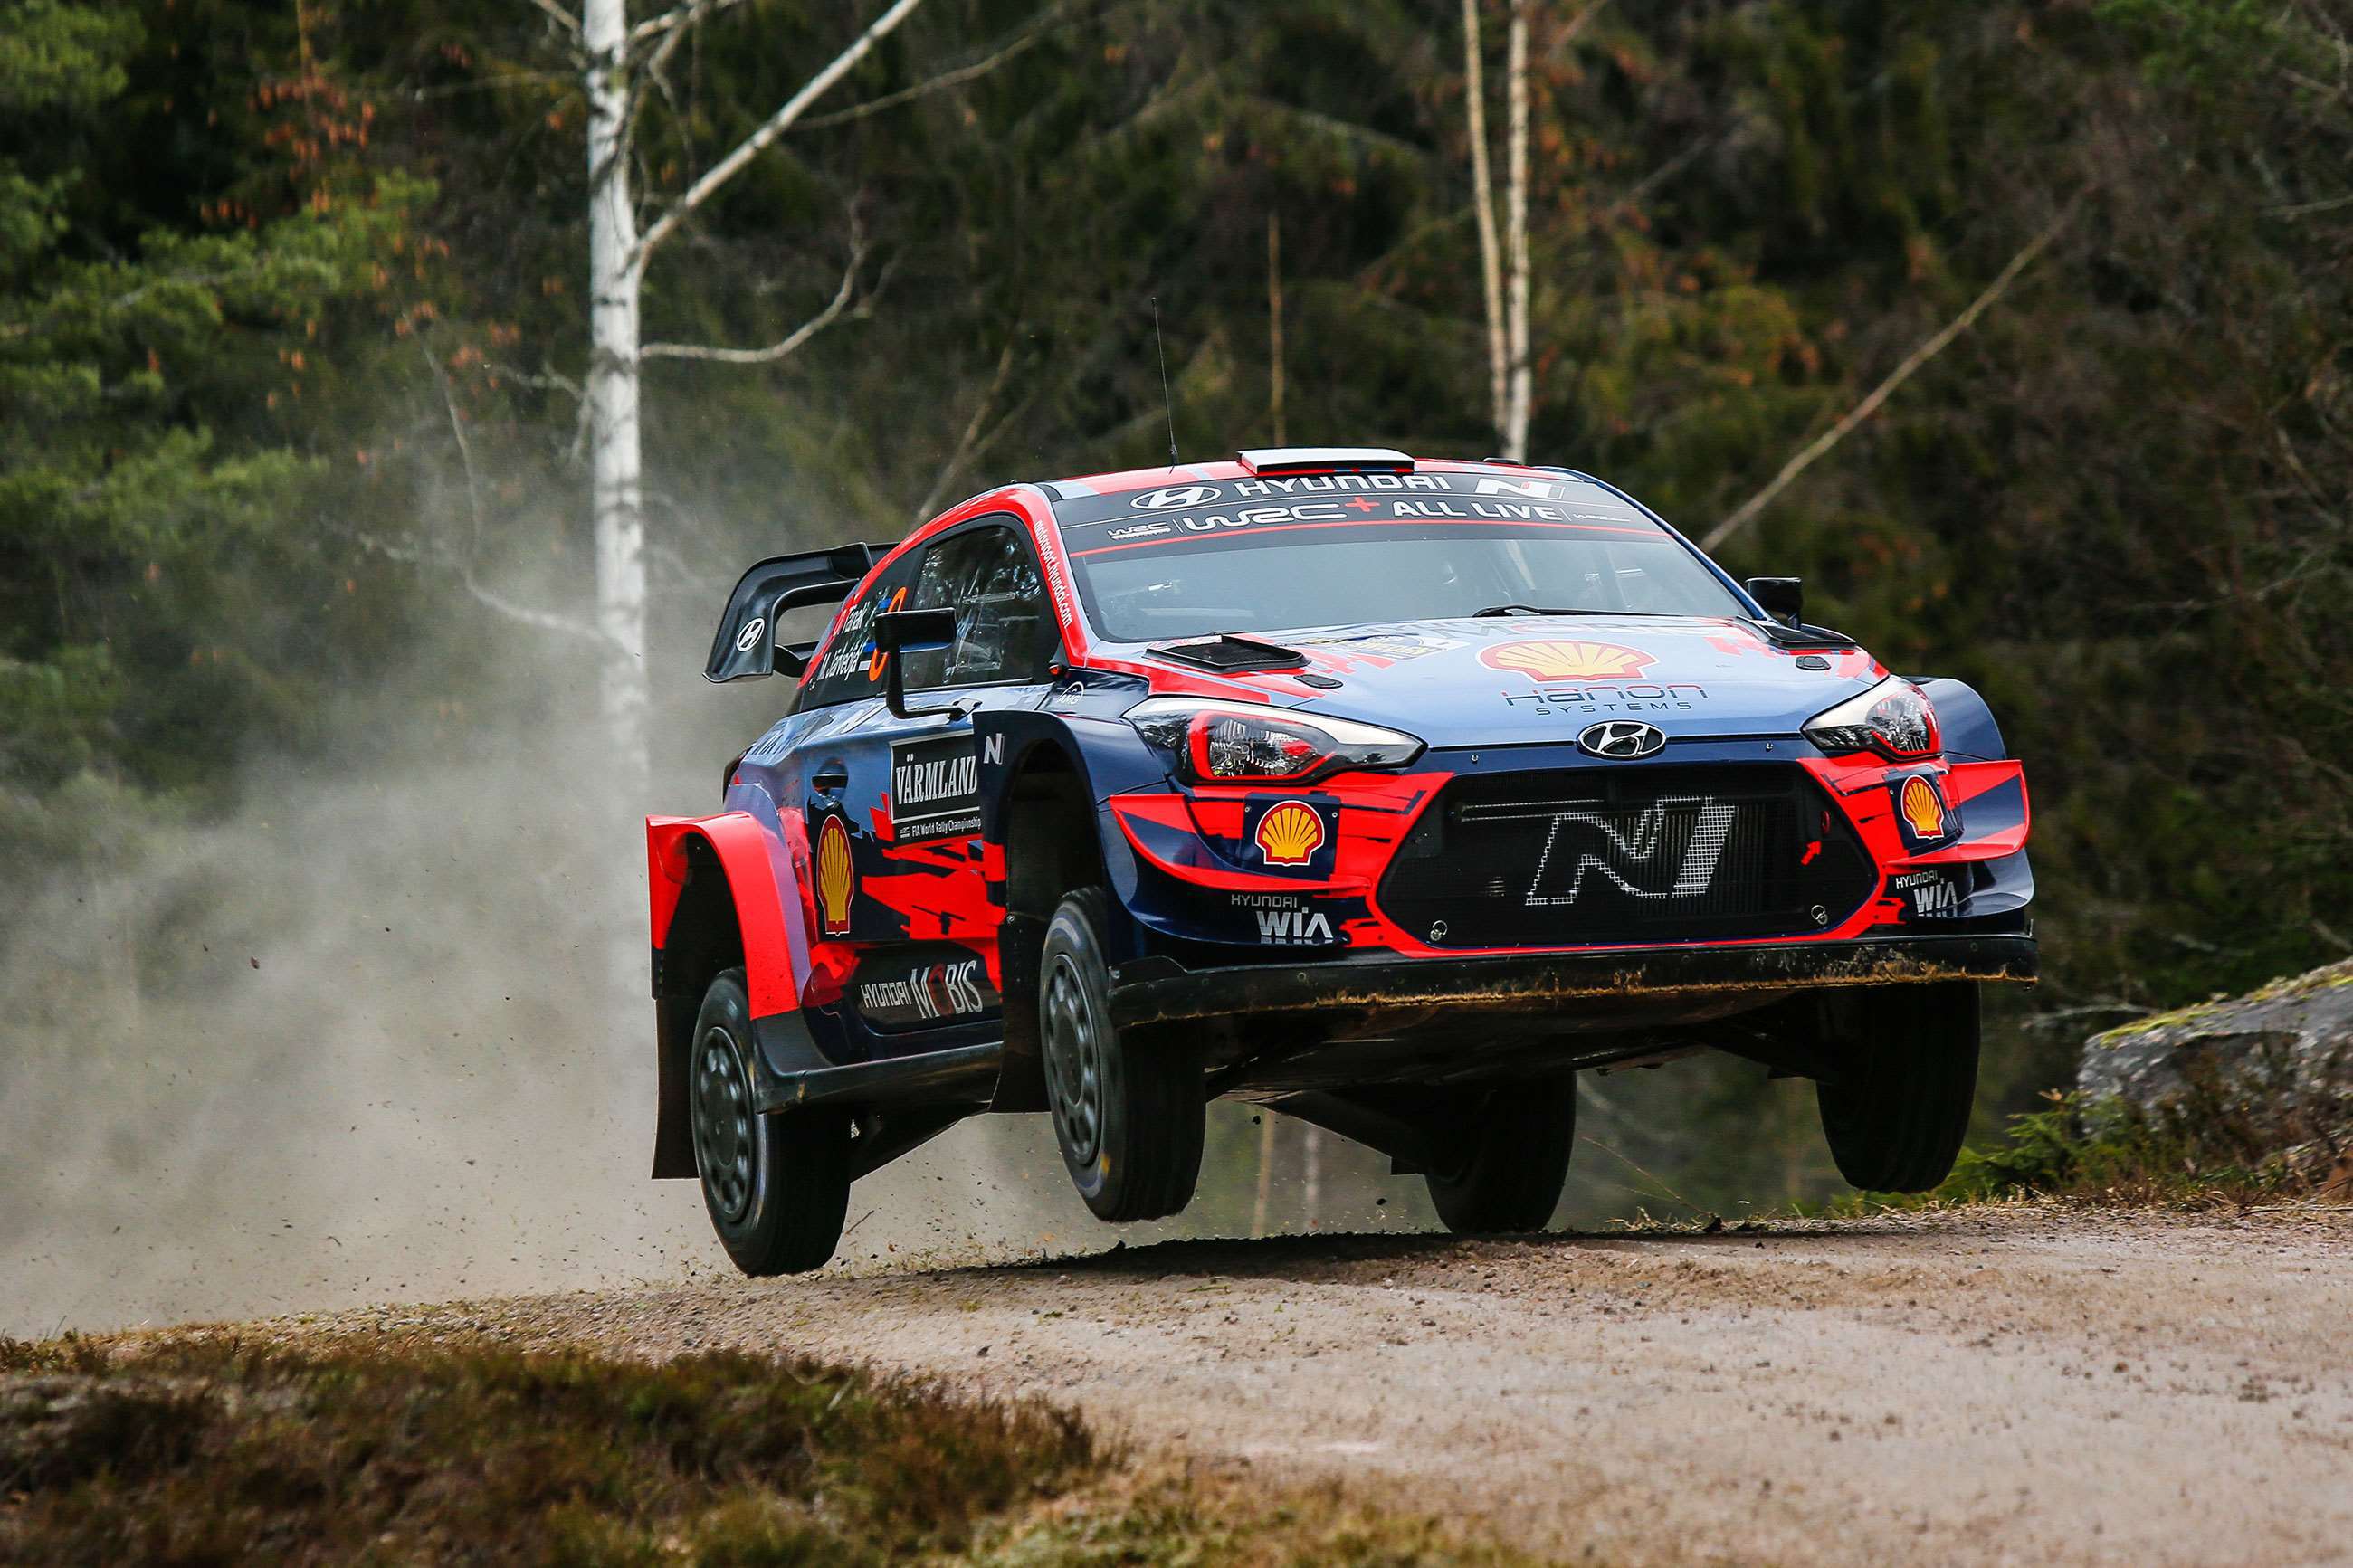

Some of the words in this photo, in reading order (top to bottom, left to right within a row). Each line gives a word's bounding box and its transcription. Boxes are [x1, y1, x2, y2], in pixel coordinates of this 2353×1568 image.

[1234, 474, 1452, 497] HYUNDAI
[1392, 499, 1468, 518] ALL
[1471, 502, 1563, 521] LIVE
[1033, 520, 1073, 630] motorsport.hyundai.com
[1535, 701, 1693, 716] SYSTEMS
[983, 733, 1005, 765] N
[895, 753, 978, 805] VÄRMLAND
[911, 824, 921, 838] FIA
[921, 822, 935, 836] World
[936, 820, 948, 834] Rally
[948, 816, 982, 832] Championship
[1525, 795, 1736, 907] N
[1895, 870, 1939, 889] HYUNDAI
[1913, 877, 1957, 914] WIA
[1231, 894, 1298, 908] HYUNDAI
[1256, 907, 1334, 939] WIA
[860, 981, 912, 1009] HYUNDAI
[910, 959, 983, 1020] MOBIS
